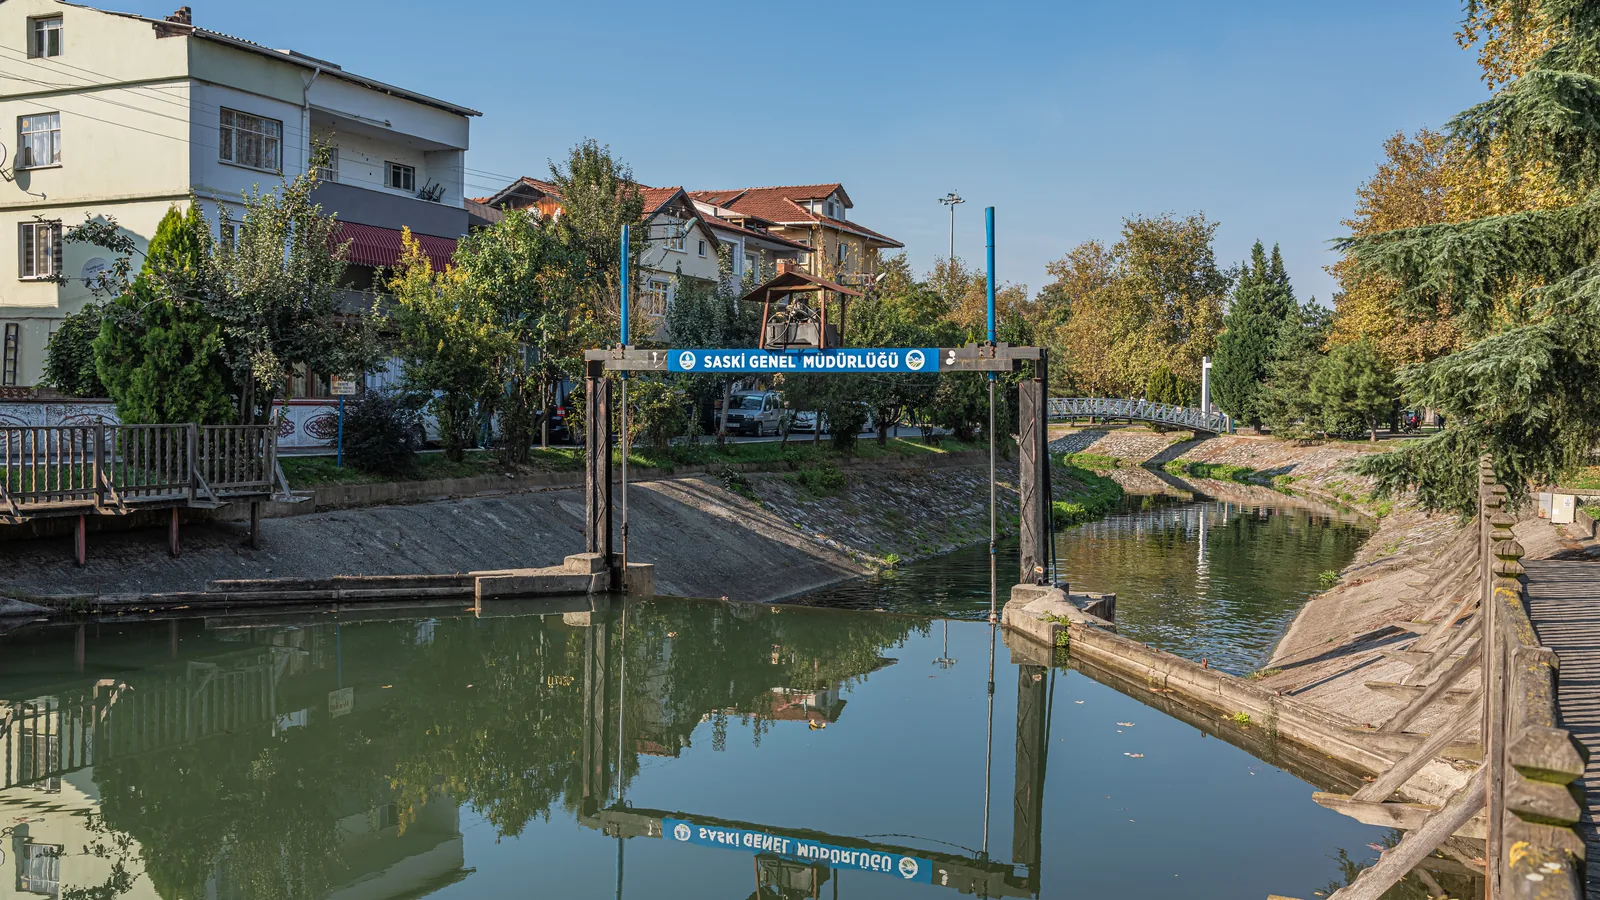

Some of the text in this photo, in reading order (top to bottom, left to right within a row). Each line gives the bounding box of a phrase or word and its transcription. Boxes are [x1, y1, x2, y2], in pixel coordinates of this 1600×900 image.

[703, 352, 899, 368] SASKİ GENEL MÜDÜRLÜĞÜ
